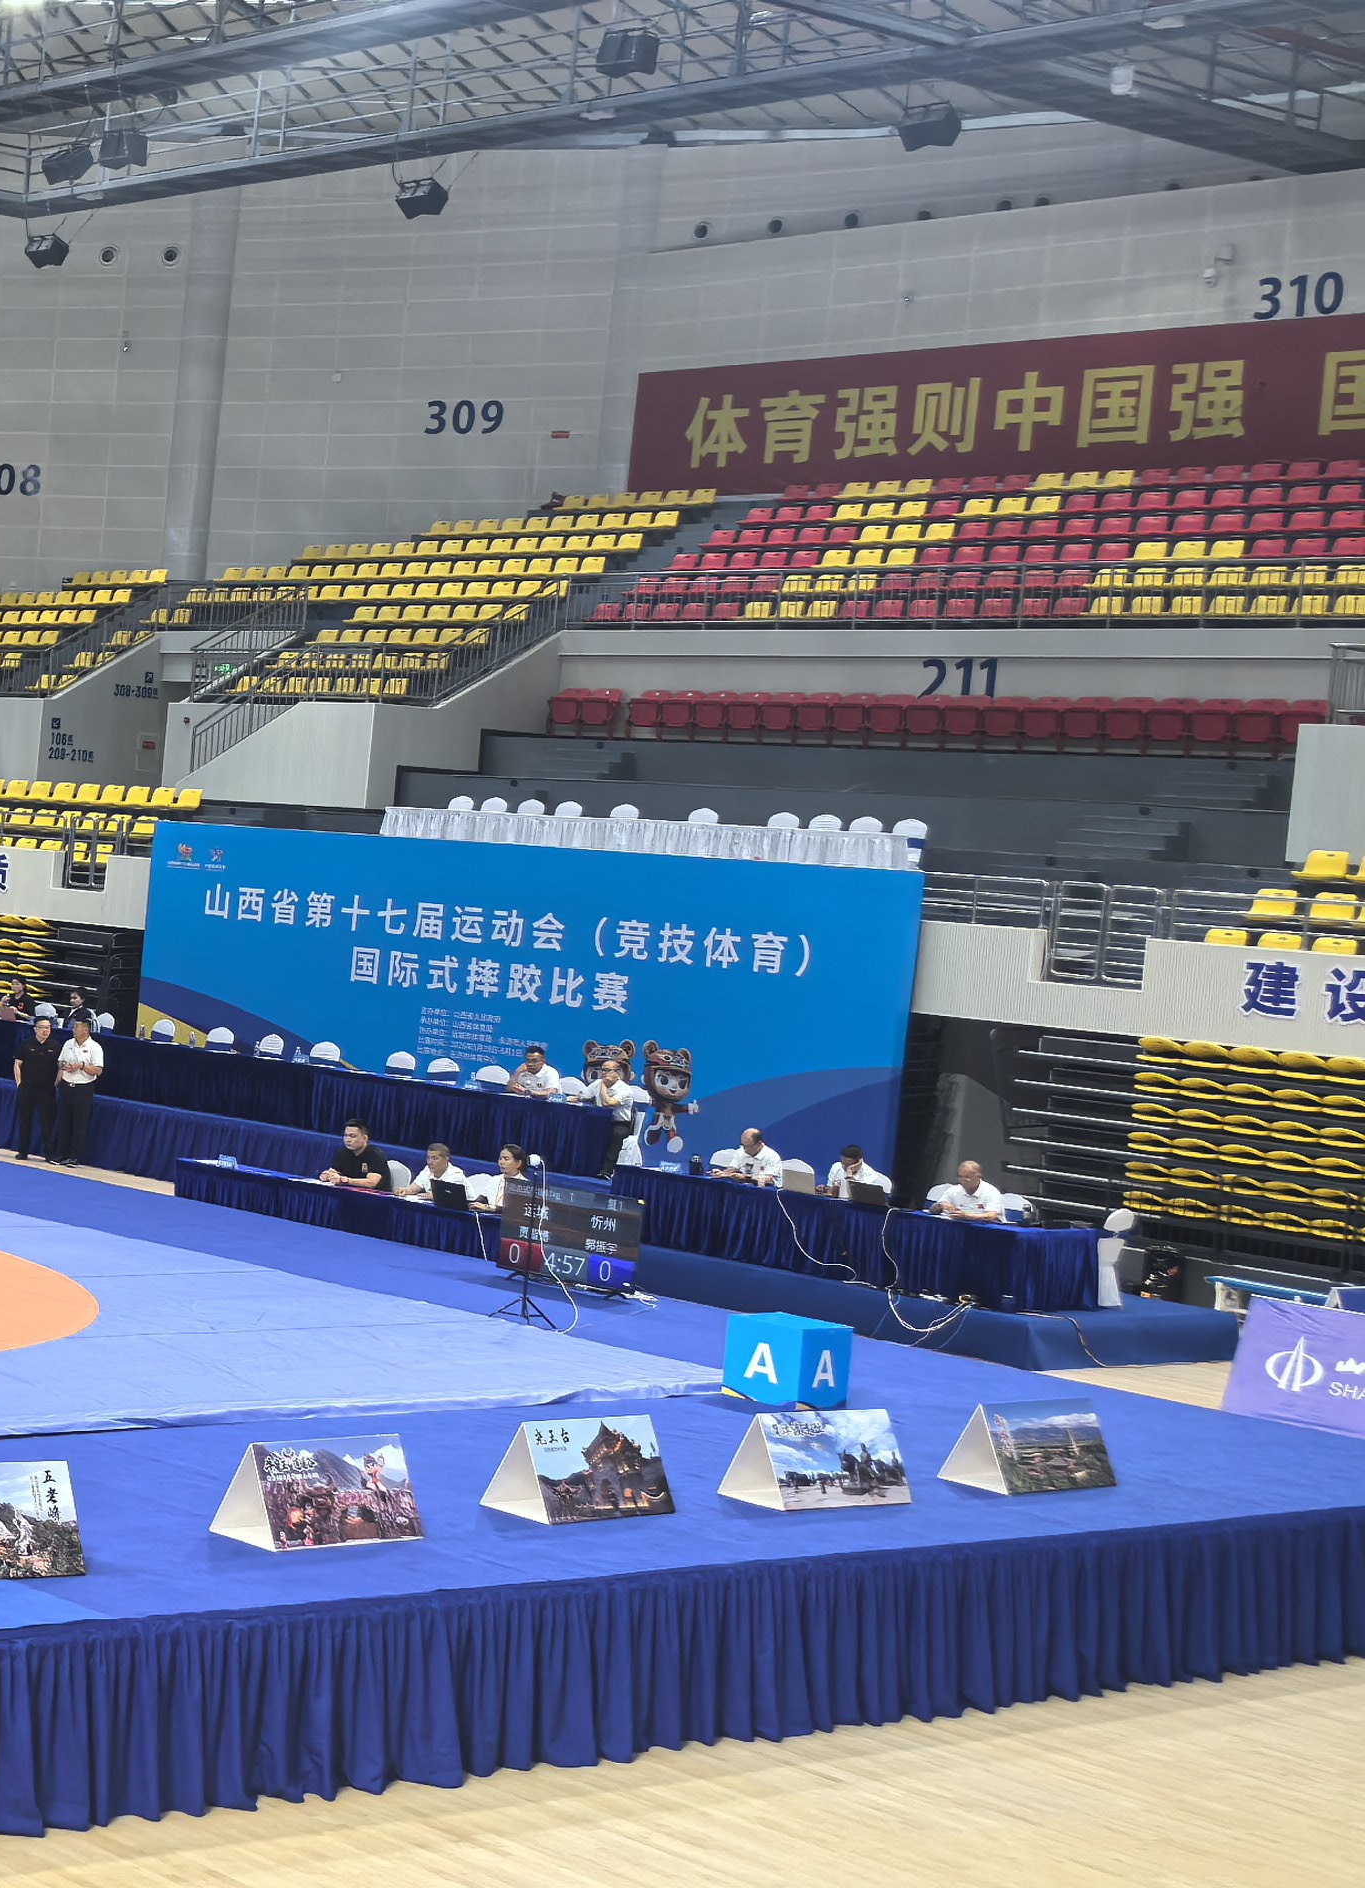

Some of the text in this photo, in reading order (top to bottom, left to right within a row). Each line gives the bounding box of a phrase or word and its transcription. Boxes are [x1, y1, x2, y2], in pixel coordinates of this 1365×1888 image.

[1254, 271, 1344, 321] 310
[424, 400, 504, 435] 309
[685, 360, 1246, 468] 体育强则中国强
[919, 658, 998, 699] 211
[204, 883, 813, 979] 山西省第十七届运动会（竞技体育）
[348, 945, 630, 1014] 国际式摔跤比赛
[509, 1243, 520, 1264] 0
[544, 1252, 586, 1276] 4:57
[599, 1260, 611, 1282] 0
[744, 1342, 778, 1384] A
[811, 1350, 836, 1389] A
